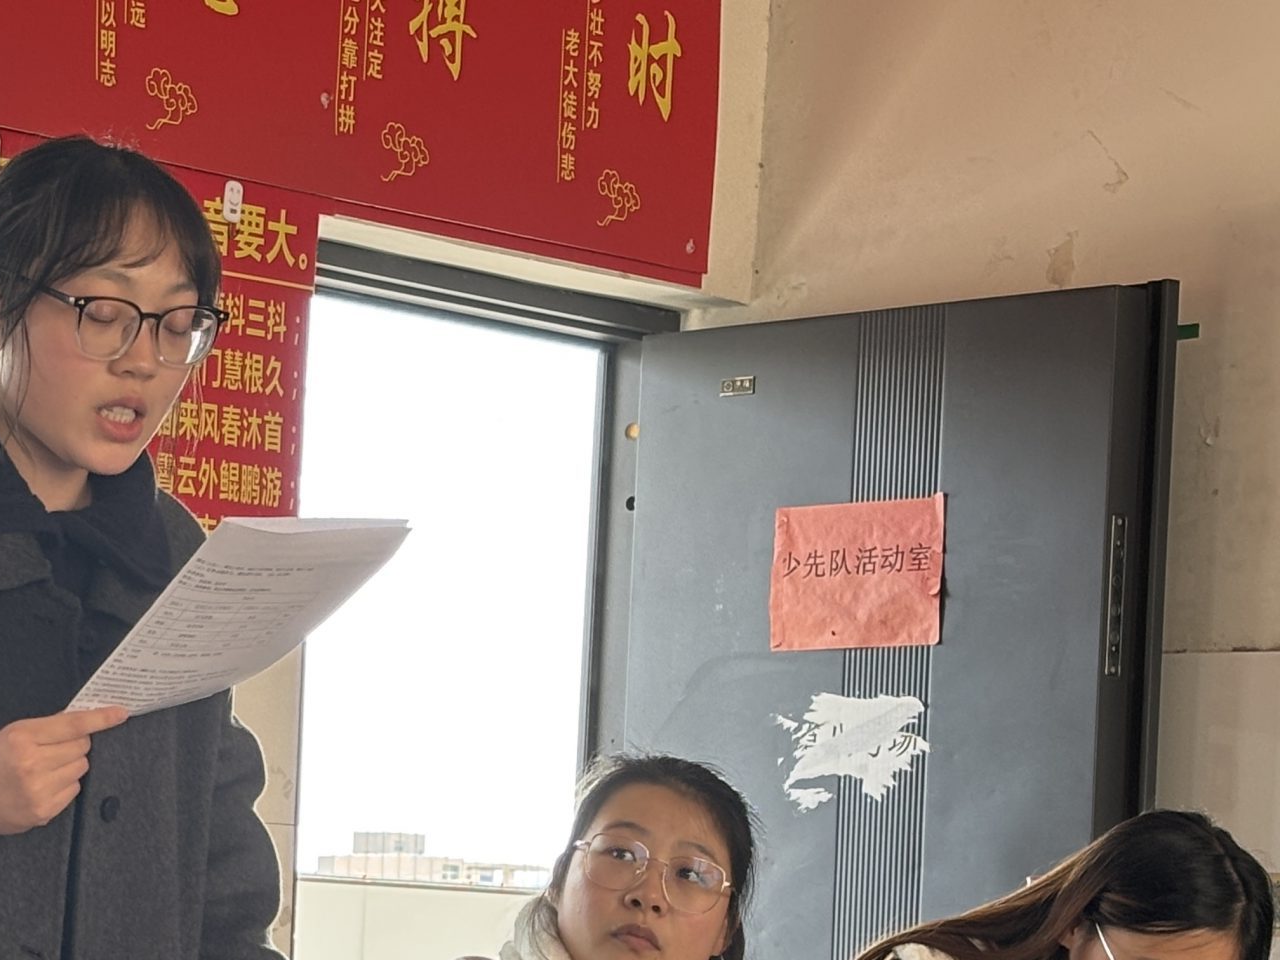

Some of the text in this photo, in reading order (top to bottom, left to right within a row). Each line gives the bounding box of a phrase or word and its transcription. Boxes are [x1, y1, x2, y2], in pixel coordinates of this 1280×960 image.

[100, 0, 116, 87] 以明志
[130, 0, 146, 28] 远
[339, 0, 360, 135] 分靠打拼
[561, 28, 580, 181] 老大徒伤悲
[586, 0, 605, 129] 壮不努力
[627, 10, 682, 122] 时
[218, 292, 301, 345] 抖三抖；
[782, 543, 932, 580] 少先队活动室
